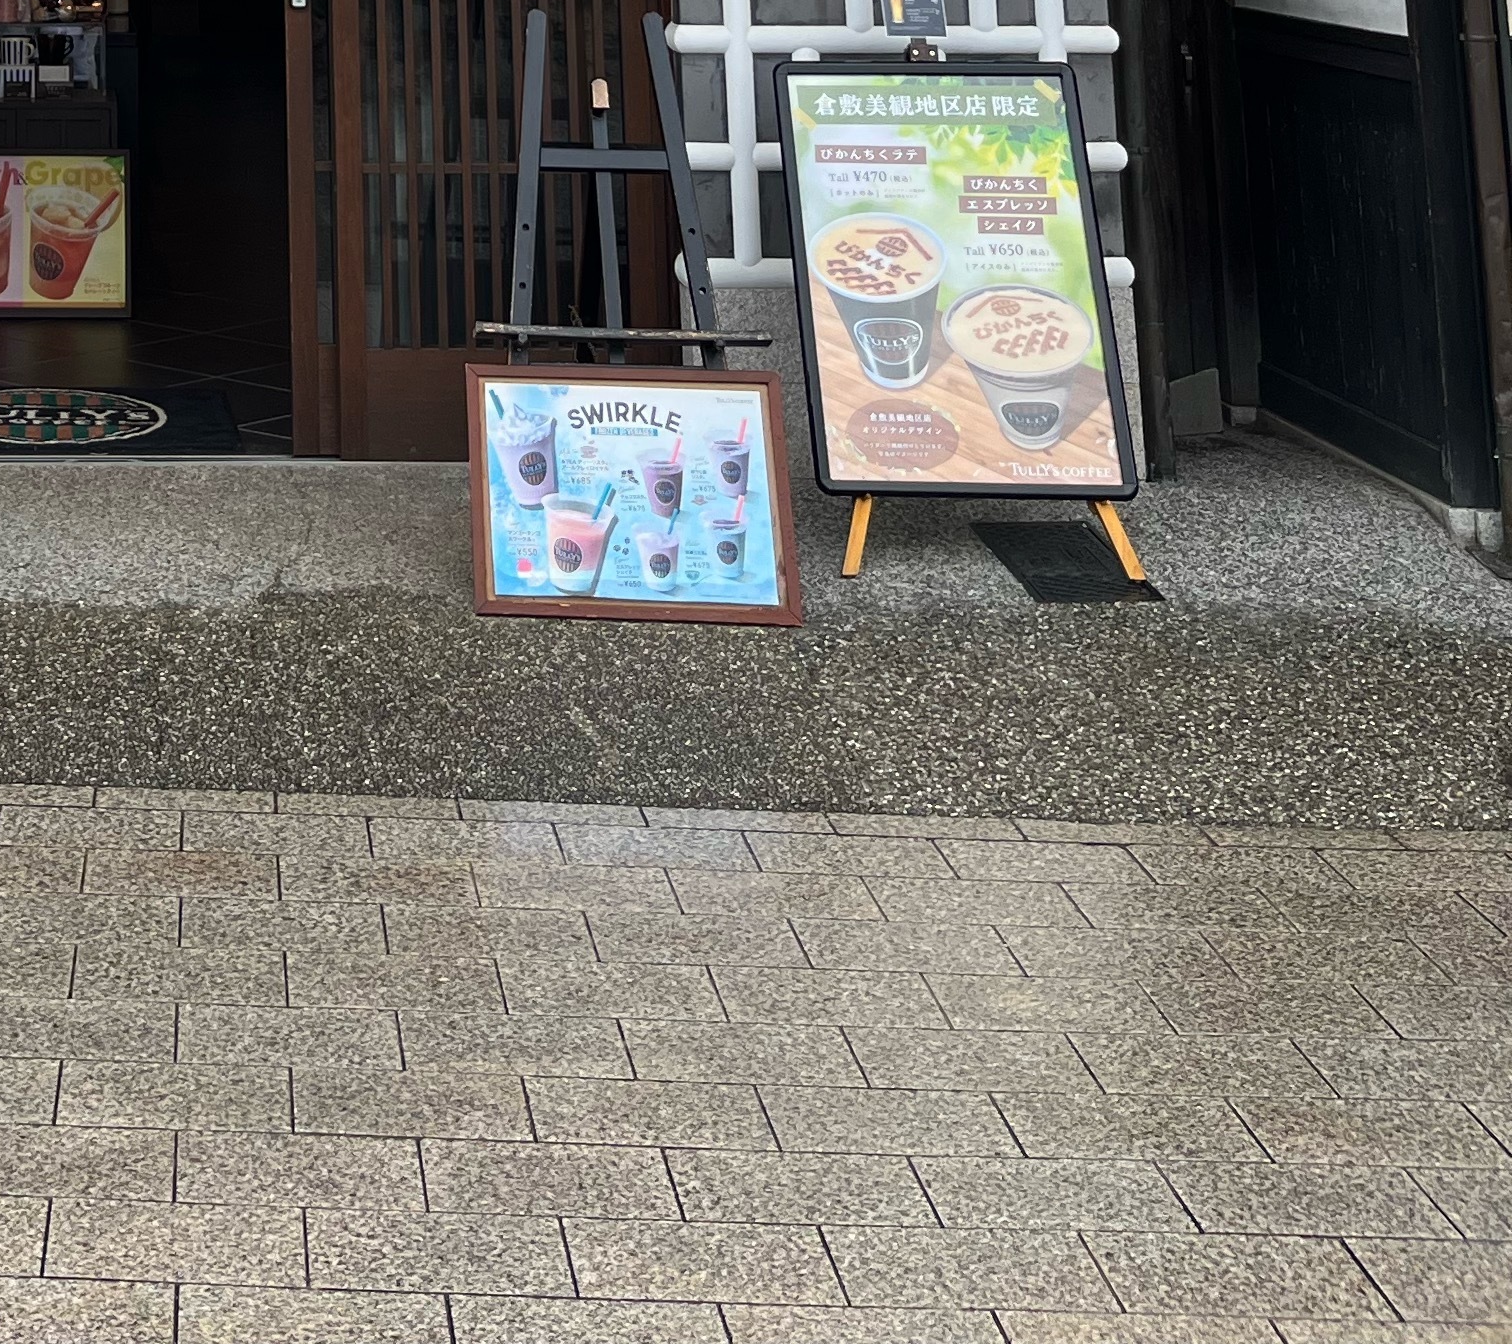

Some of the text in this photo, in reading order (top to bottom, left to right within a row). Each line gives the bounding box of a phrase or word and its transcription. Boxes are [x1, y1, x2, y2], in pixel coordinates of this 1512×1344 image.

[813, 93, 1040, 117] 倉敷美観地区店限定
[819, 148, 919, 162] びかんちくラテ
[25, 160, 122, 192] Grape
[828, 173, 849, 182] Tall
[852, 170, 887, 183] ¥470
[970, 178, 1038, 191] びかんちく
[966, 199, 1048, 211] エスプレッソ
[983, 220, 1036, 231] シェイク
[963, 246, 986, 256] Tall
[989, 243, 1024, 256] ¥650
[567, 401, 682, 434] SWIRKLE
[1009, 462, 1113, 478] TULLY'S COFFEE
